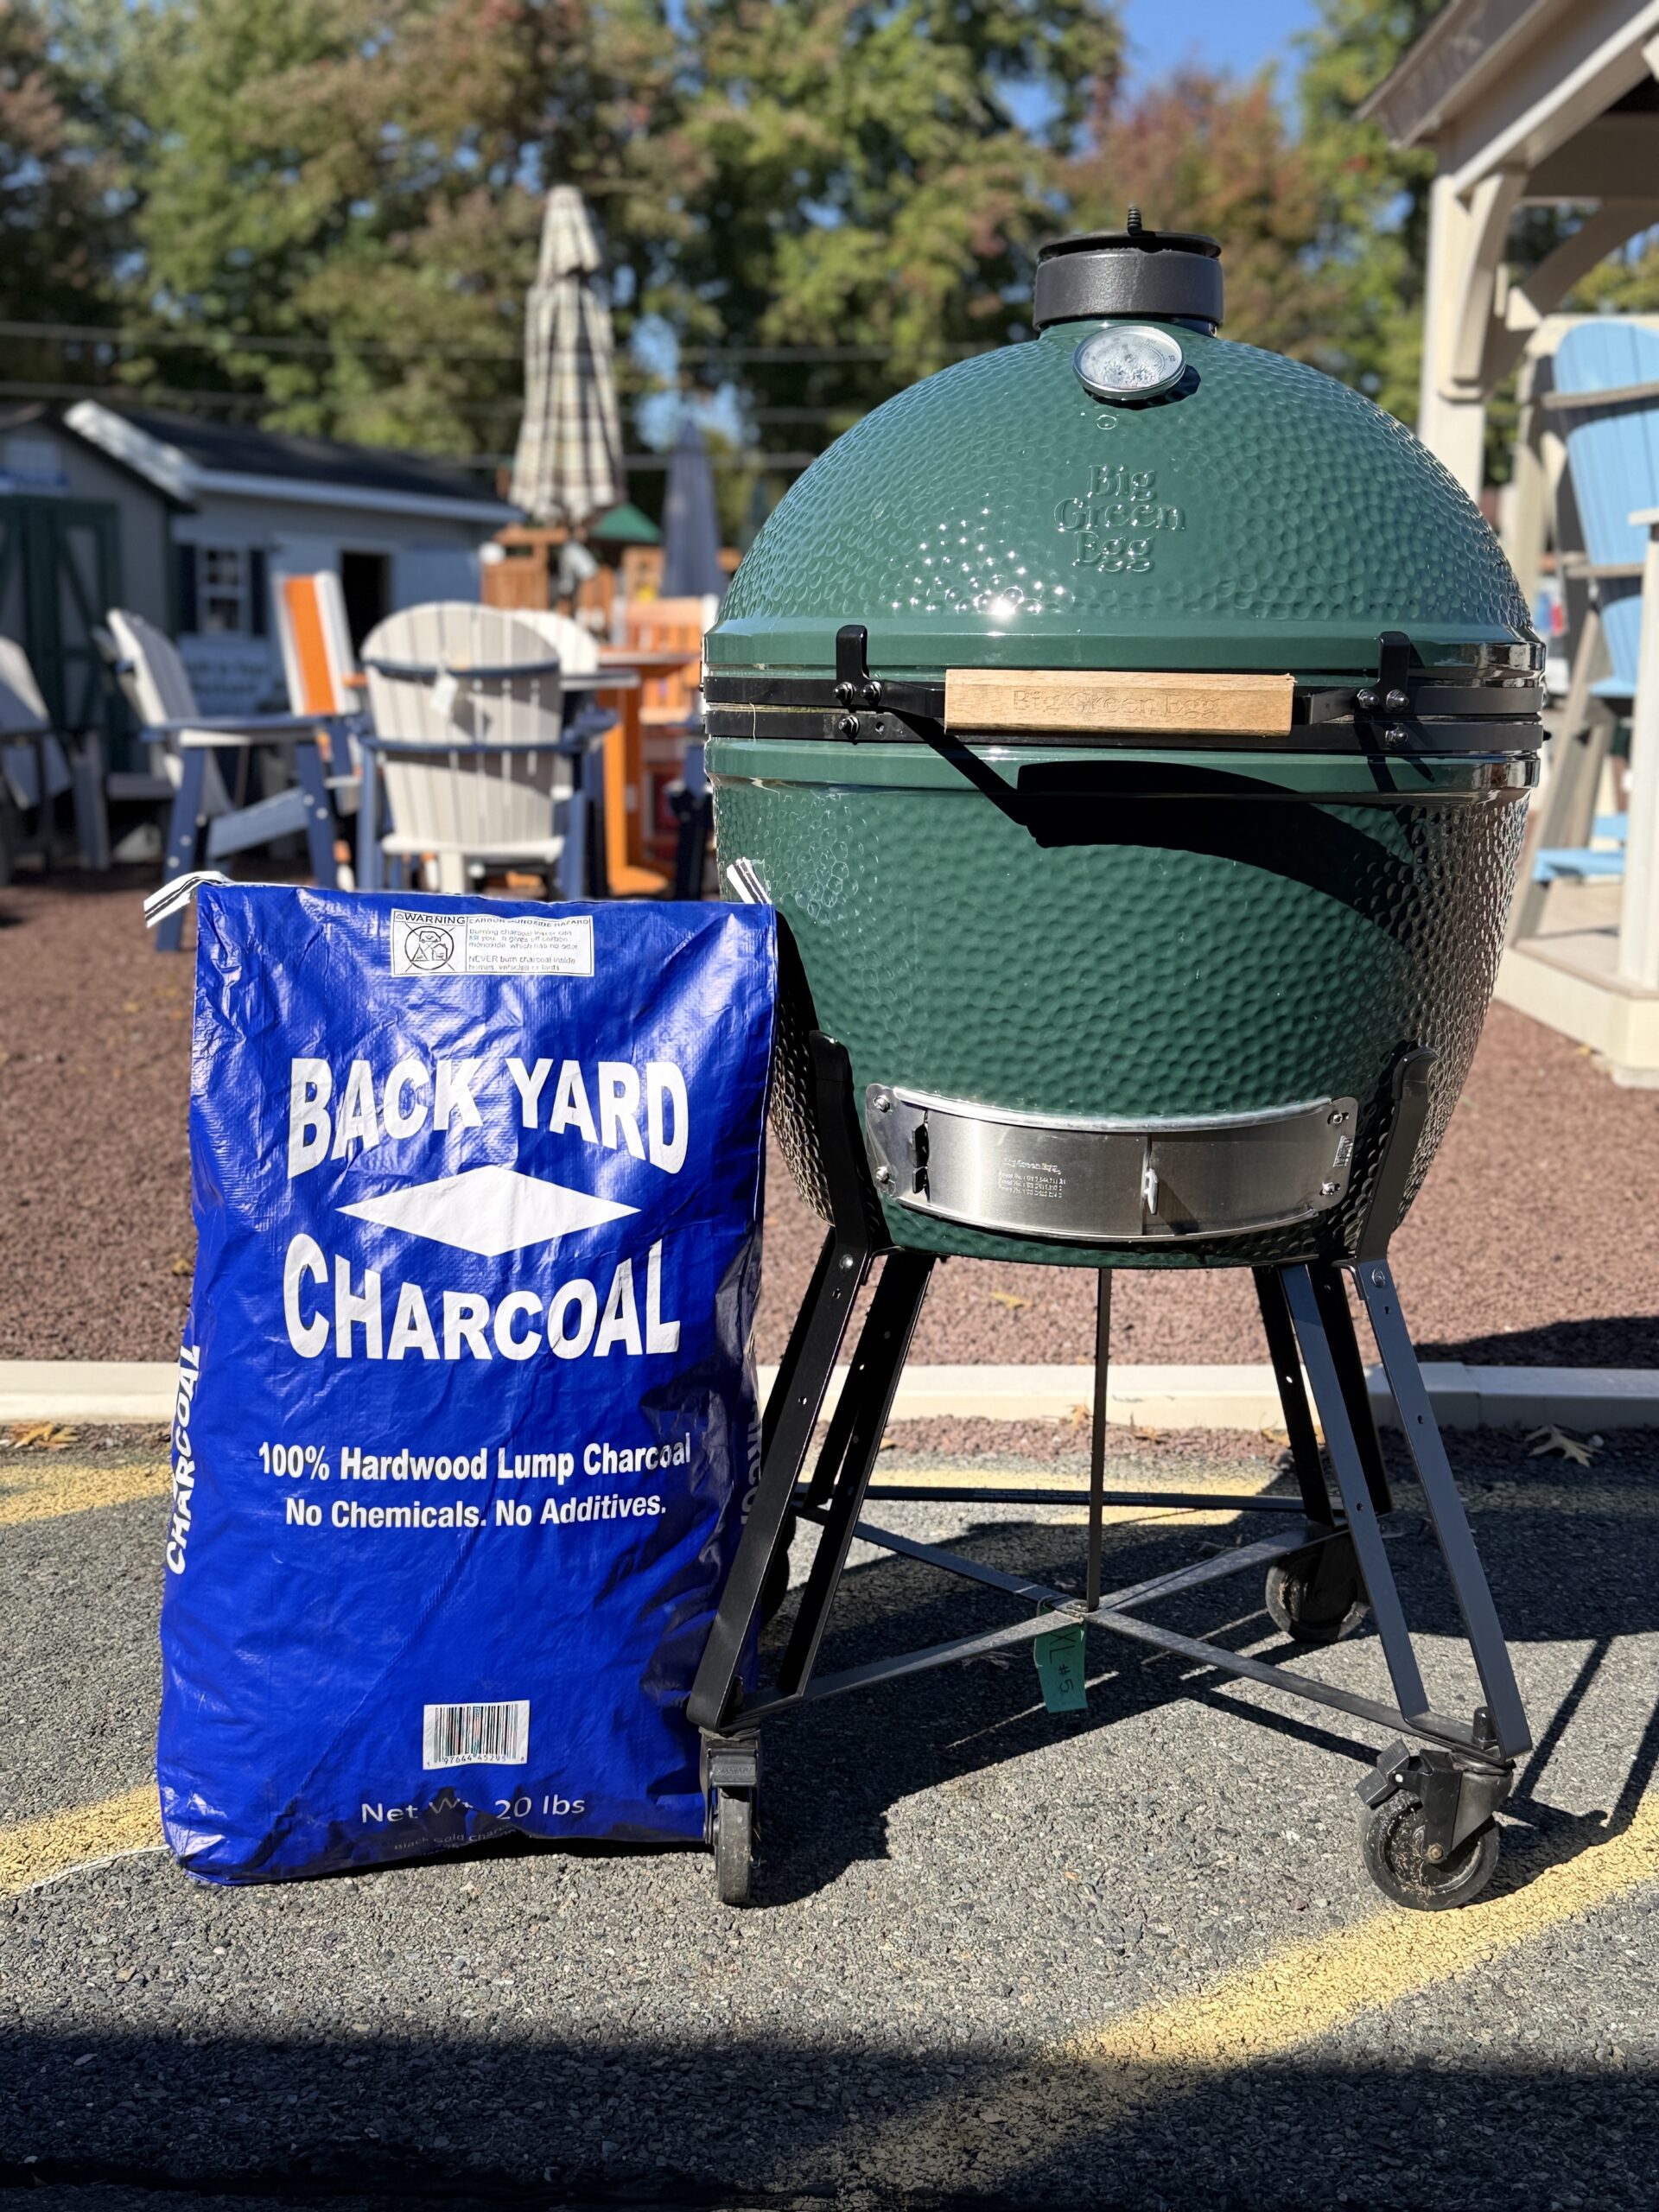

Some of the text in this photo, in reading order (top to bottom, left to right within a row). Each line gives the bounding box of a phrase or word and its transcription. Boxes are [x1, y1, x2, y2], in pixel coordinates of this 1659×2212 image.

[1087, 464, 1157, 501] Big
[1053, 498, 1186, 531] Green
[1072, 531, 1155, 573] Egg
[404, 912, 466, 925] WARNING
[288, 1058, 689, 1180] BACK YARD
[283, 1233, 681, 1361] CHARCOAL
[166, 1344, 200, 1575] CHARCOAL
[259, 1432, 690, 1485] 100% Hardwood Lump Charcoal
[285, 1494, 667, 1529] No Chemicals. No Additives.
[1049, 1631, 1077, 1665] XL
[361, 1802, 418, 1823] Net
[494, 1796, 533, 1821] 20
[543, 1794, 587, 1815] lbs
